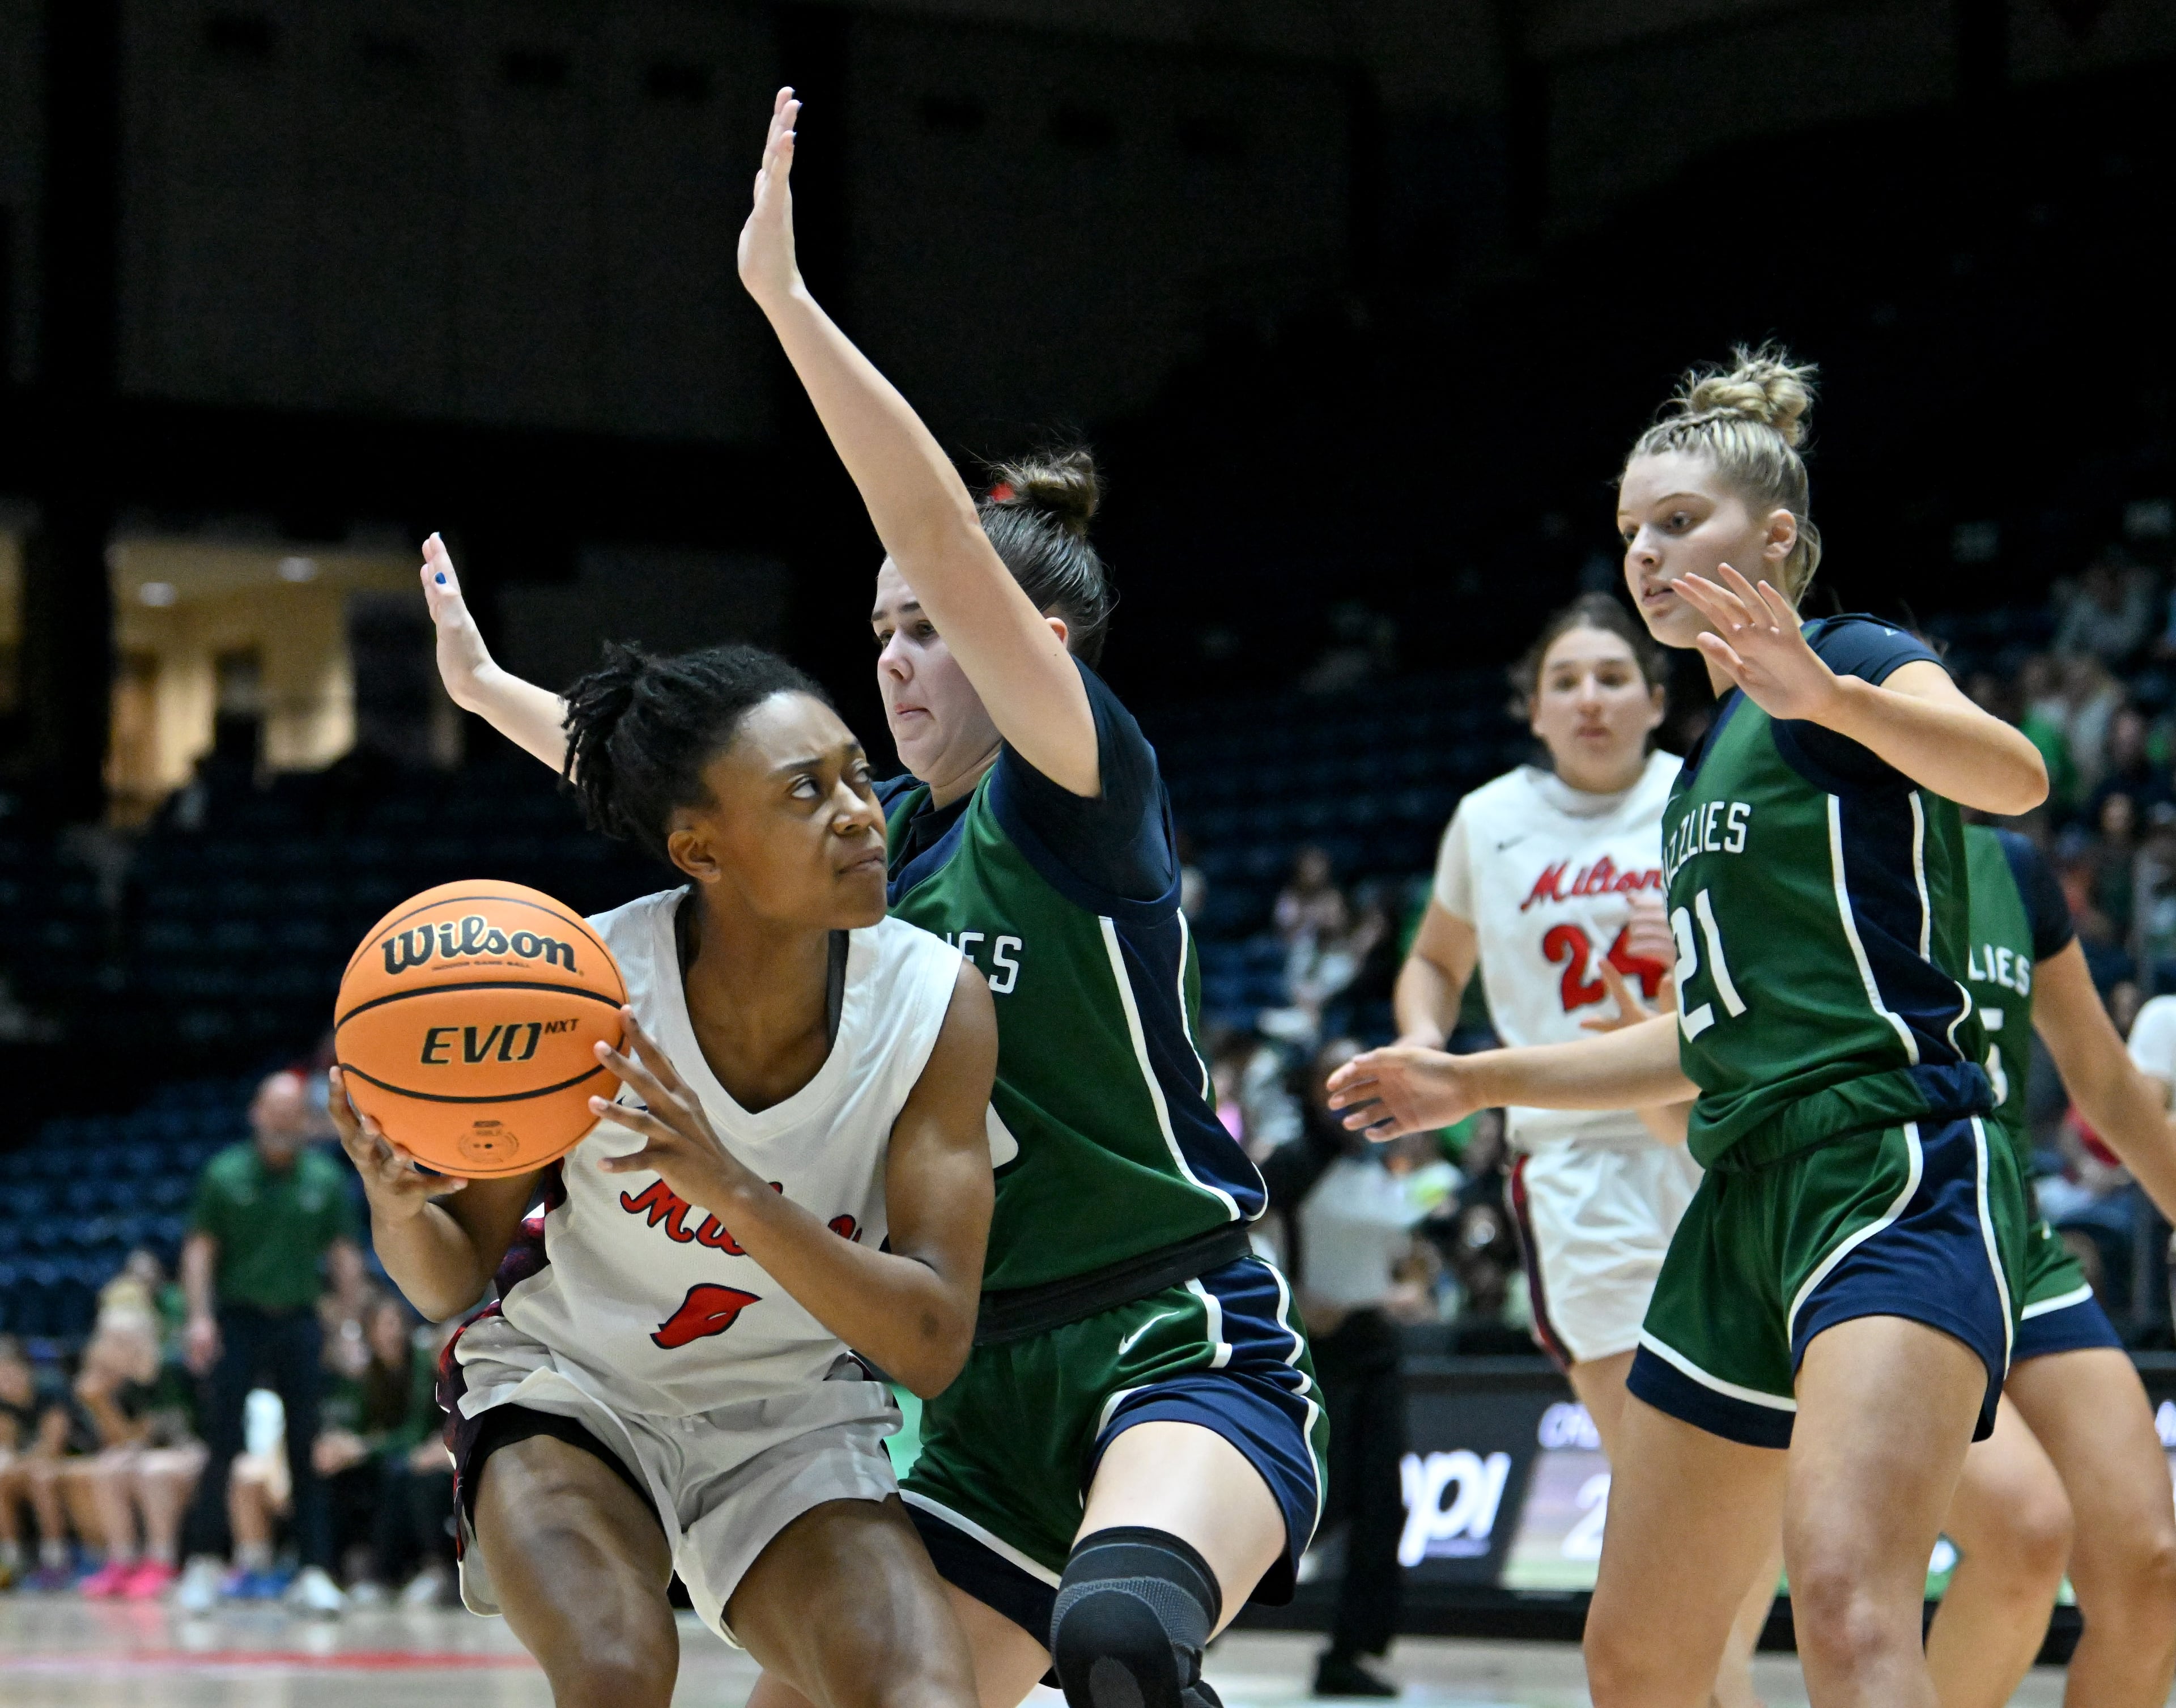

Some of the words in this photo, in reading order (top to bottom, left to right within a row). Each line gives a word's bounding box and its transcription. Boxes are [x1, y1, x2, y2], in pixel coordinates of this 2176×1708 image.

[1519, 855, 1662, 910] Milton
[381, 915, 577, 975] Wilson
[1669, 888, 1747, 1044] 21
[420, 1022, 542, 1065] EVO
[545, 1018, 580, 1035] NXT
